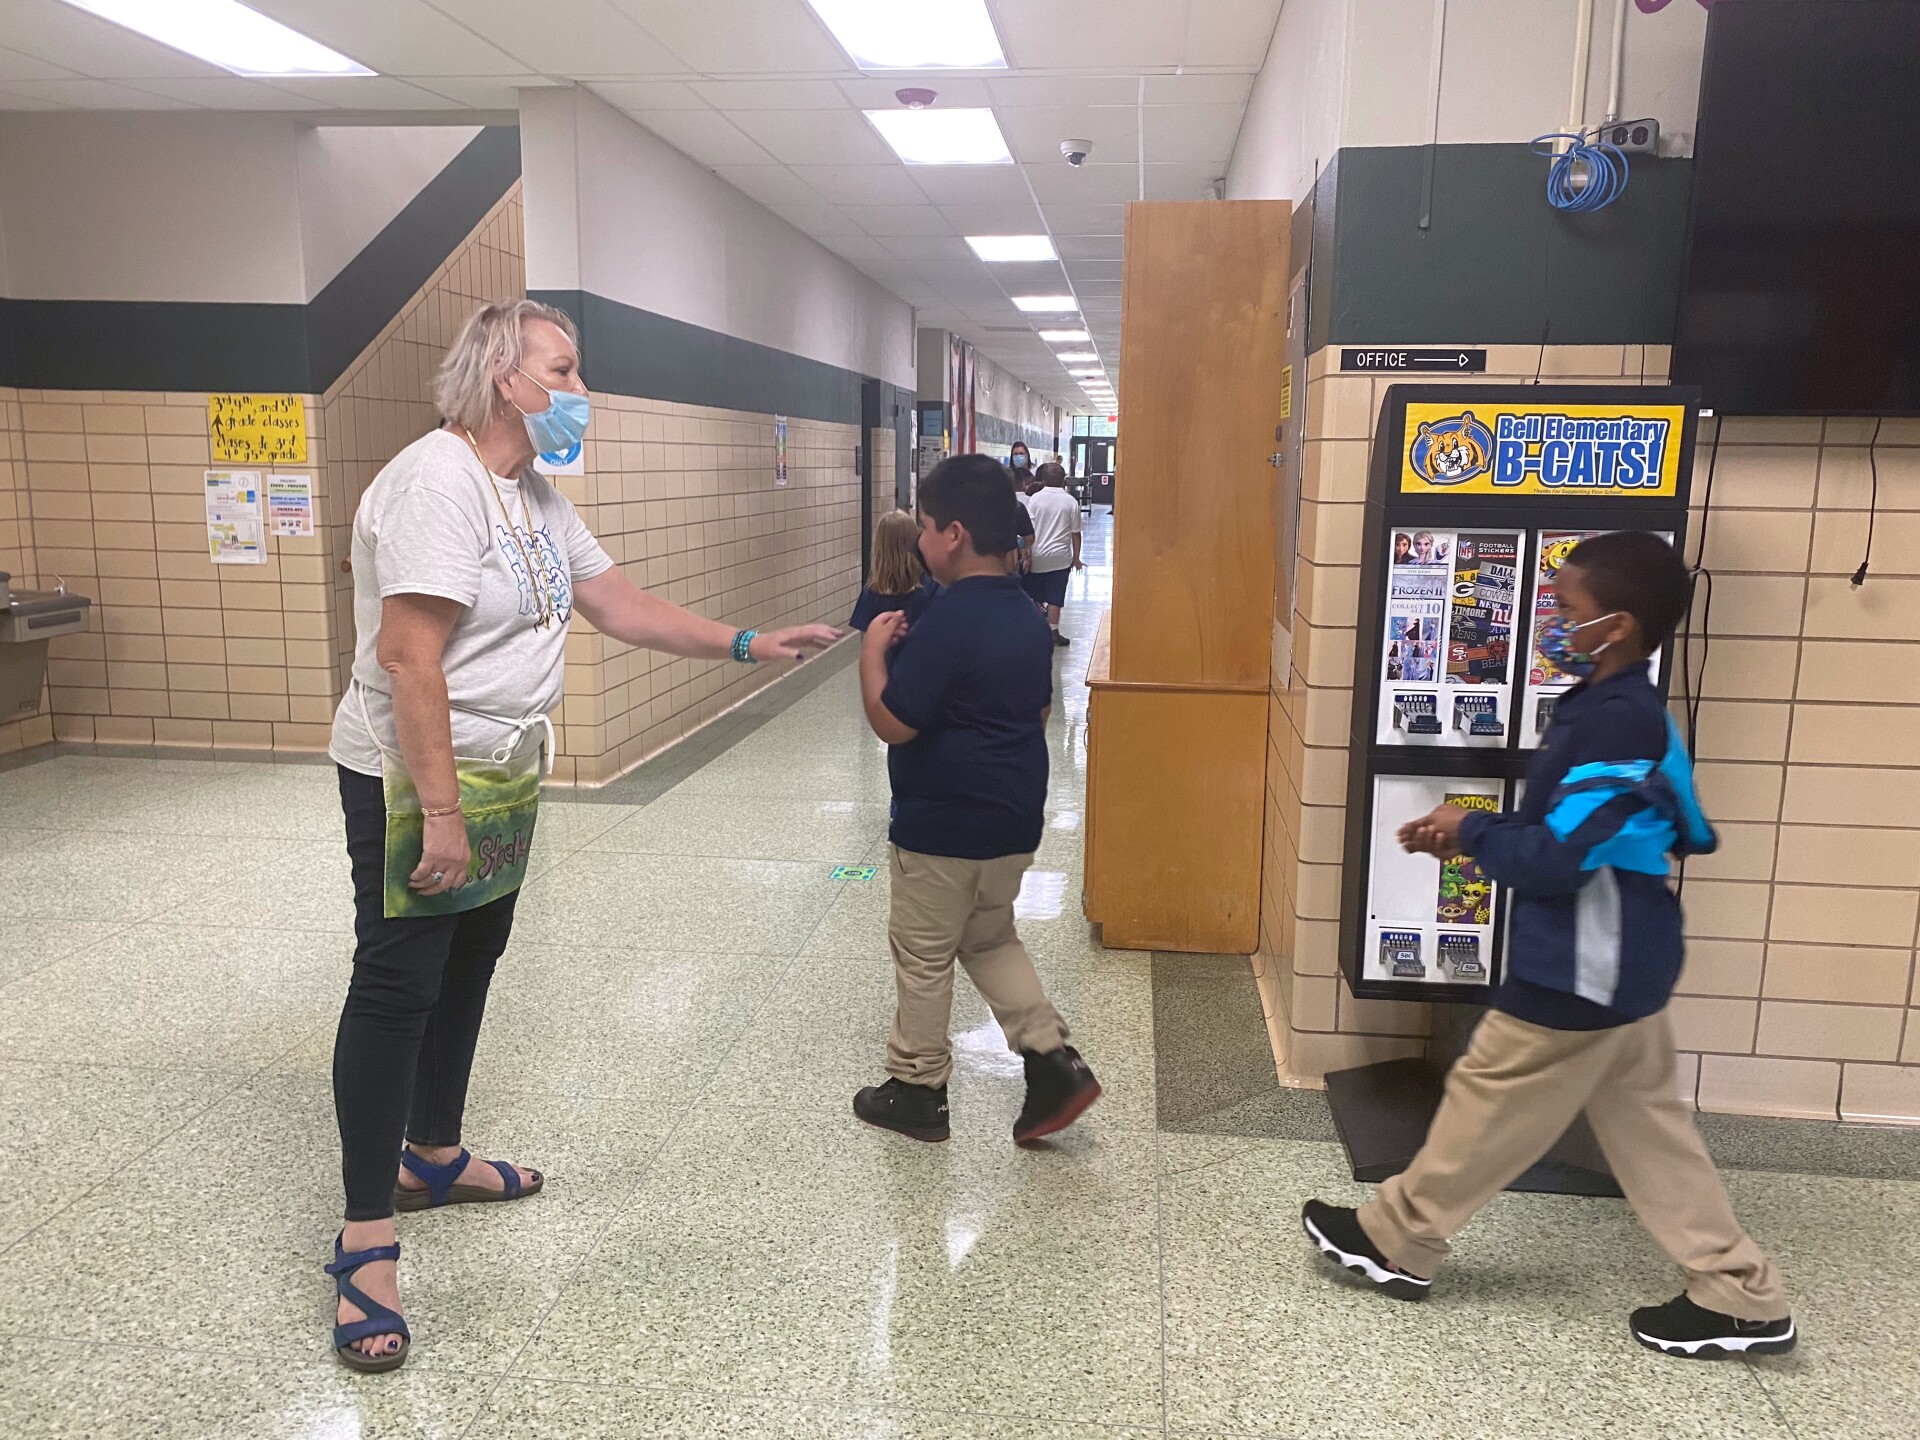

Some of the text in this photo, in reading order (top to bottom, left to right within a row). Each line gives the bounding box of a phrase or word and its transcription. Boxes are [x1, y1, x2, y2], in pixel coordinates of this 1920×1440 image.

[1356, 352, 1408, 367] OFFICE
[260, 400, 279, 413] and
[225, 414, 300, 431] grade classes
[1499, 417, 1666, 443] Bell Elementary
[216, 433, 251, 450] clases
[258, 434, 268, 450] de
[267, 447, 298, 464] grado
[1495, 440, 1662, 485] B-CATS!
[1391, 585, 1434, 595] FROZEN
[1425, 603, 1441, 615] 10
